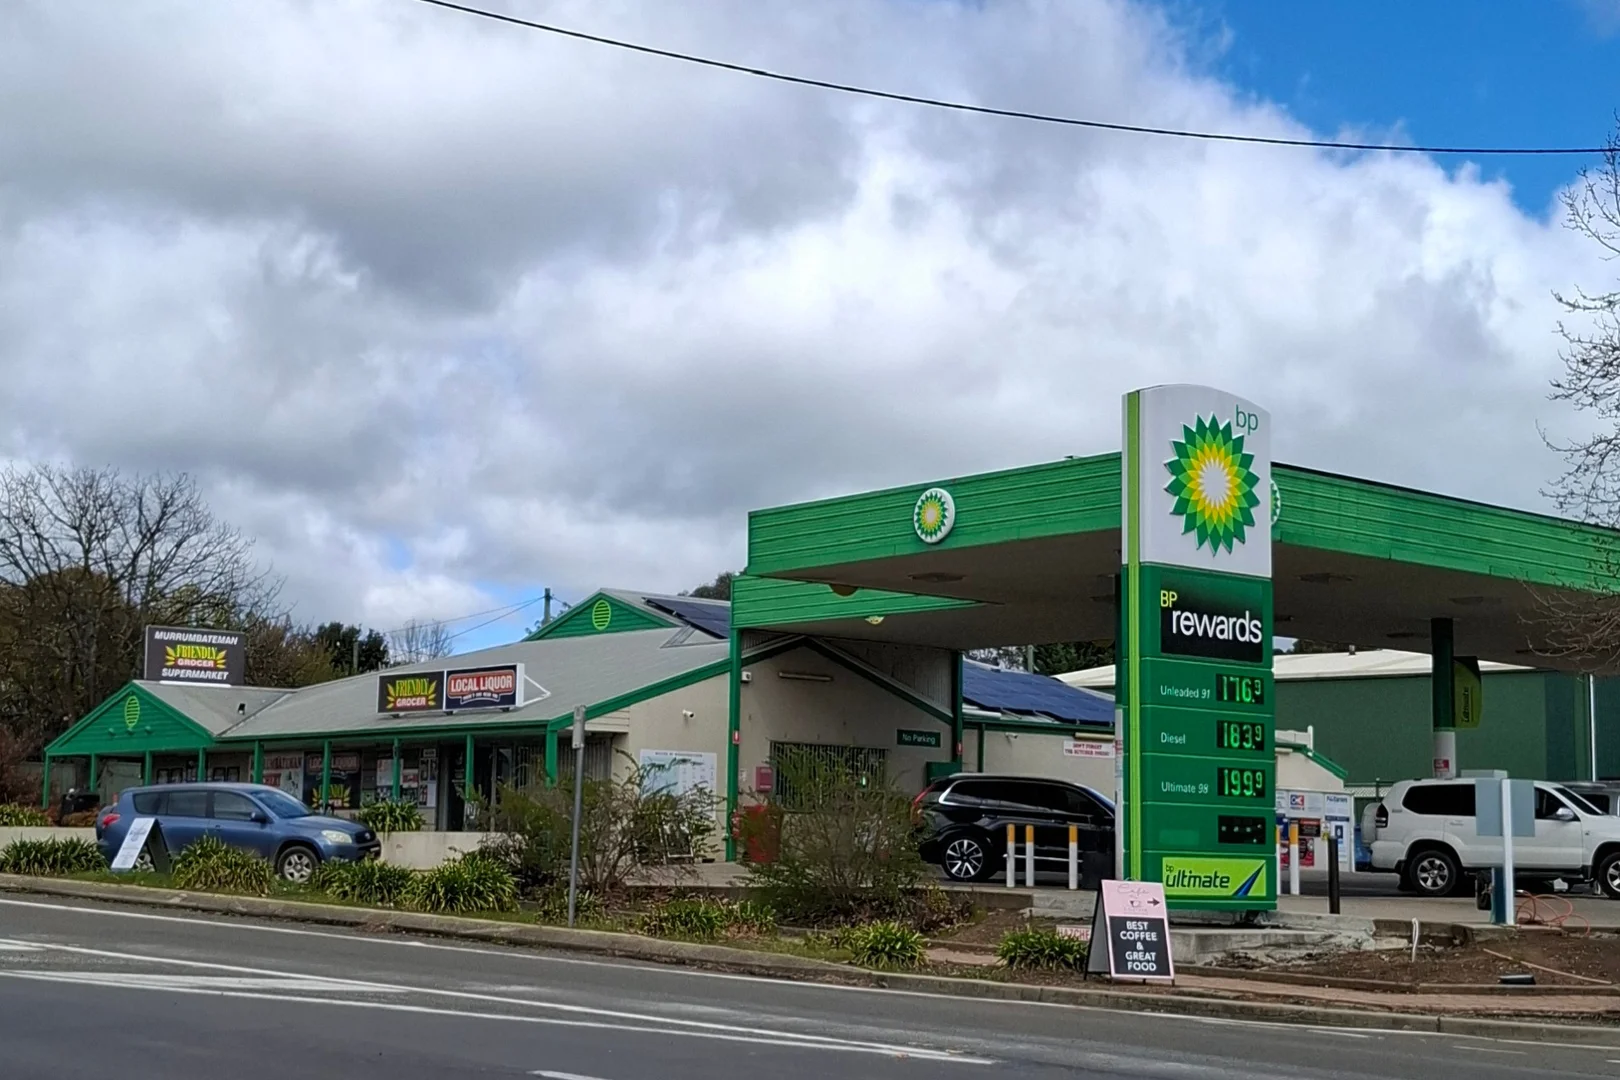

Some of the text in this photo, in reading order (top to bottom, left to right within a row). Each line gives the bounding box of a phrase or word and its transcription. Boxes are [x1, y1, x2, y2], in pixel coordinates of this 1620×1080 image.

[1236, 404, 1258, 435] bp
[1160, 590, 1178, 608] BP
[1172, 610, 1262, 643] rewards
[154, 631, 238, 645] MURRUMBATEMAN
[176, 644, 218, 660] FRIENDLY
[177, 658, 214, 668] GROCER
[161, 668, 229, 680] SUPERMARKET
[395, 677, 429, 697] FRIENDLY
[451, 674, 513, 693] LOCAL LIQUOR
[1160, 685, 1211, 699] Unleaded 91
[396, 697, 426, 708] GROCER
[902, 733, 936, 745] No Parking
[1160, 732, 1186, 744] Diesel
[1161, 781, 1209, 794] Ultimate 98
[1166, 869, 1231, 888] ultimate
[1126, 921, 1149, 931] BEST
[1119, 931, 1158, 941] COFFEE
[1136, 942, 1144, 951] &
[1125, 951, 1157, 962] GREAT
[1127, 962, 1157, 972] FOOD
